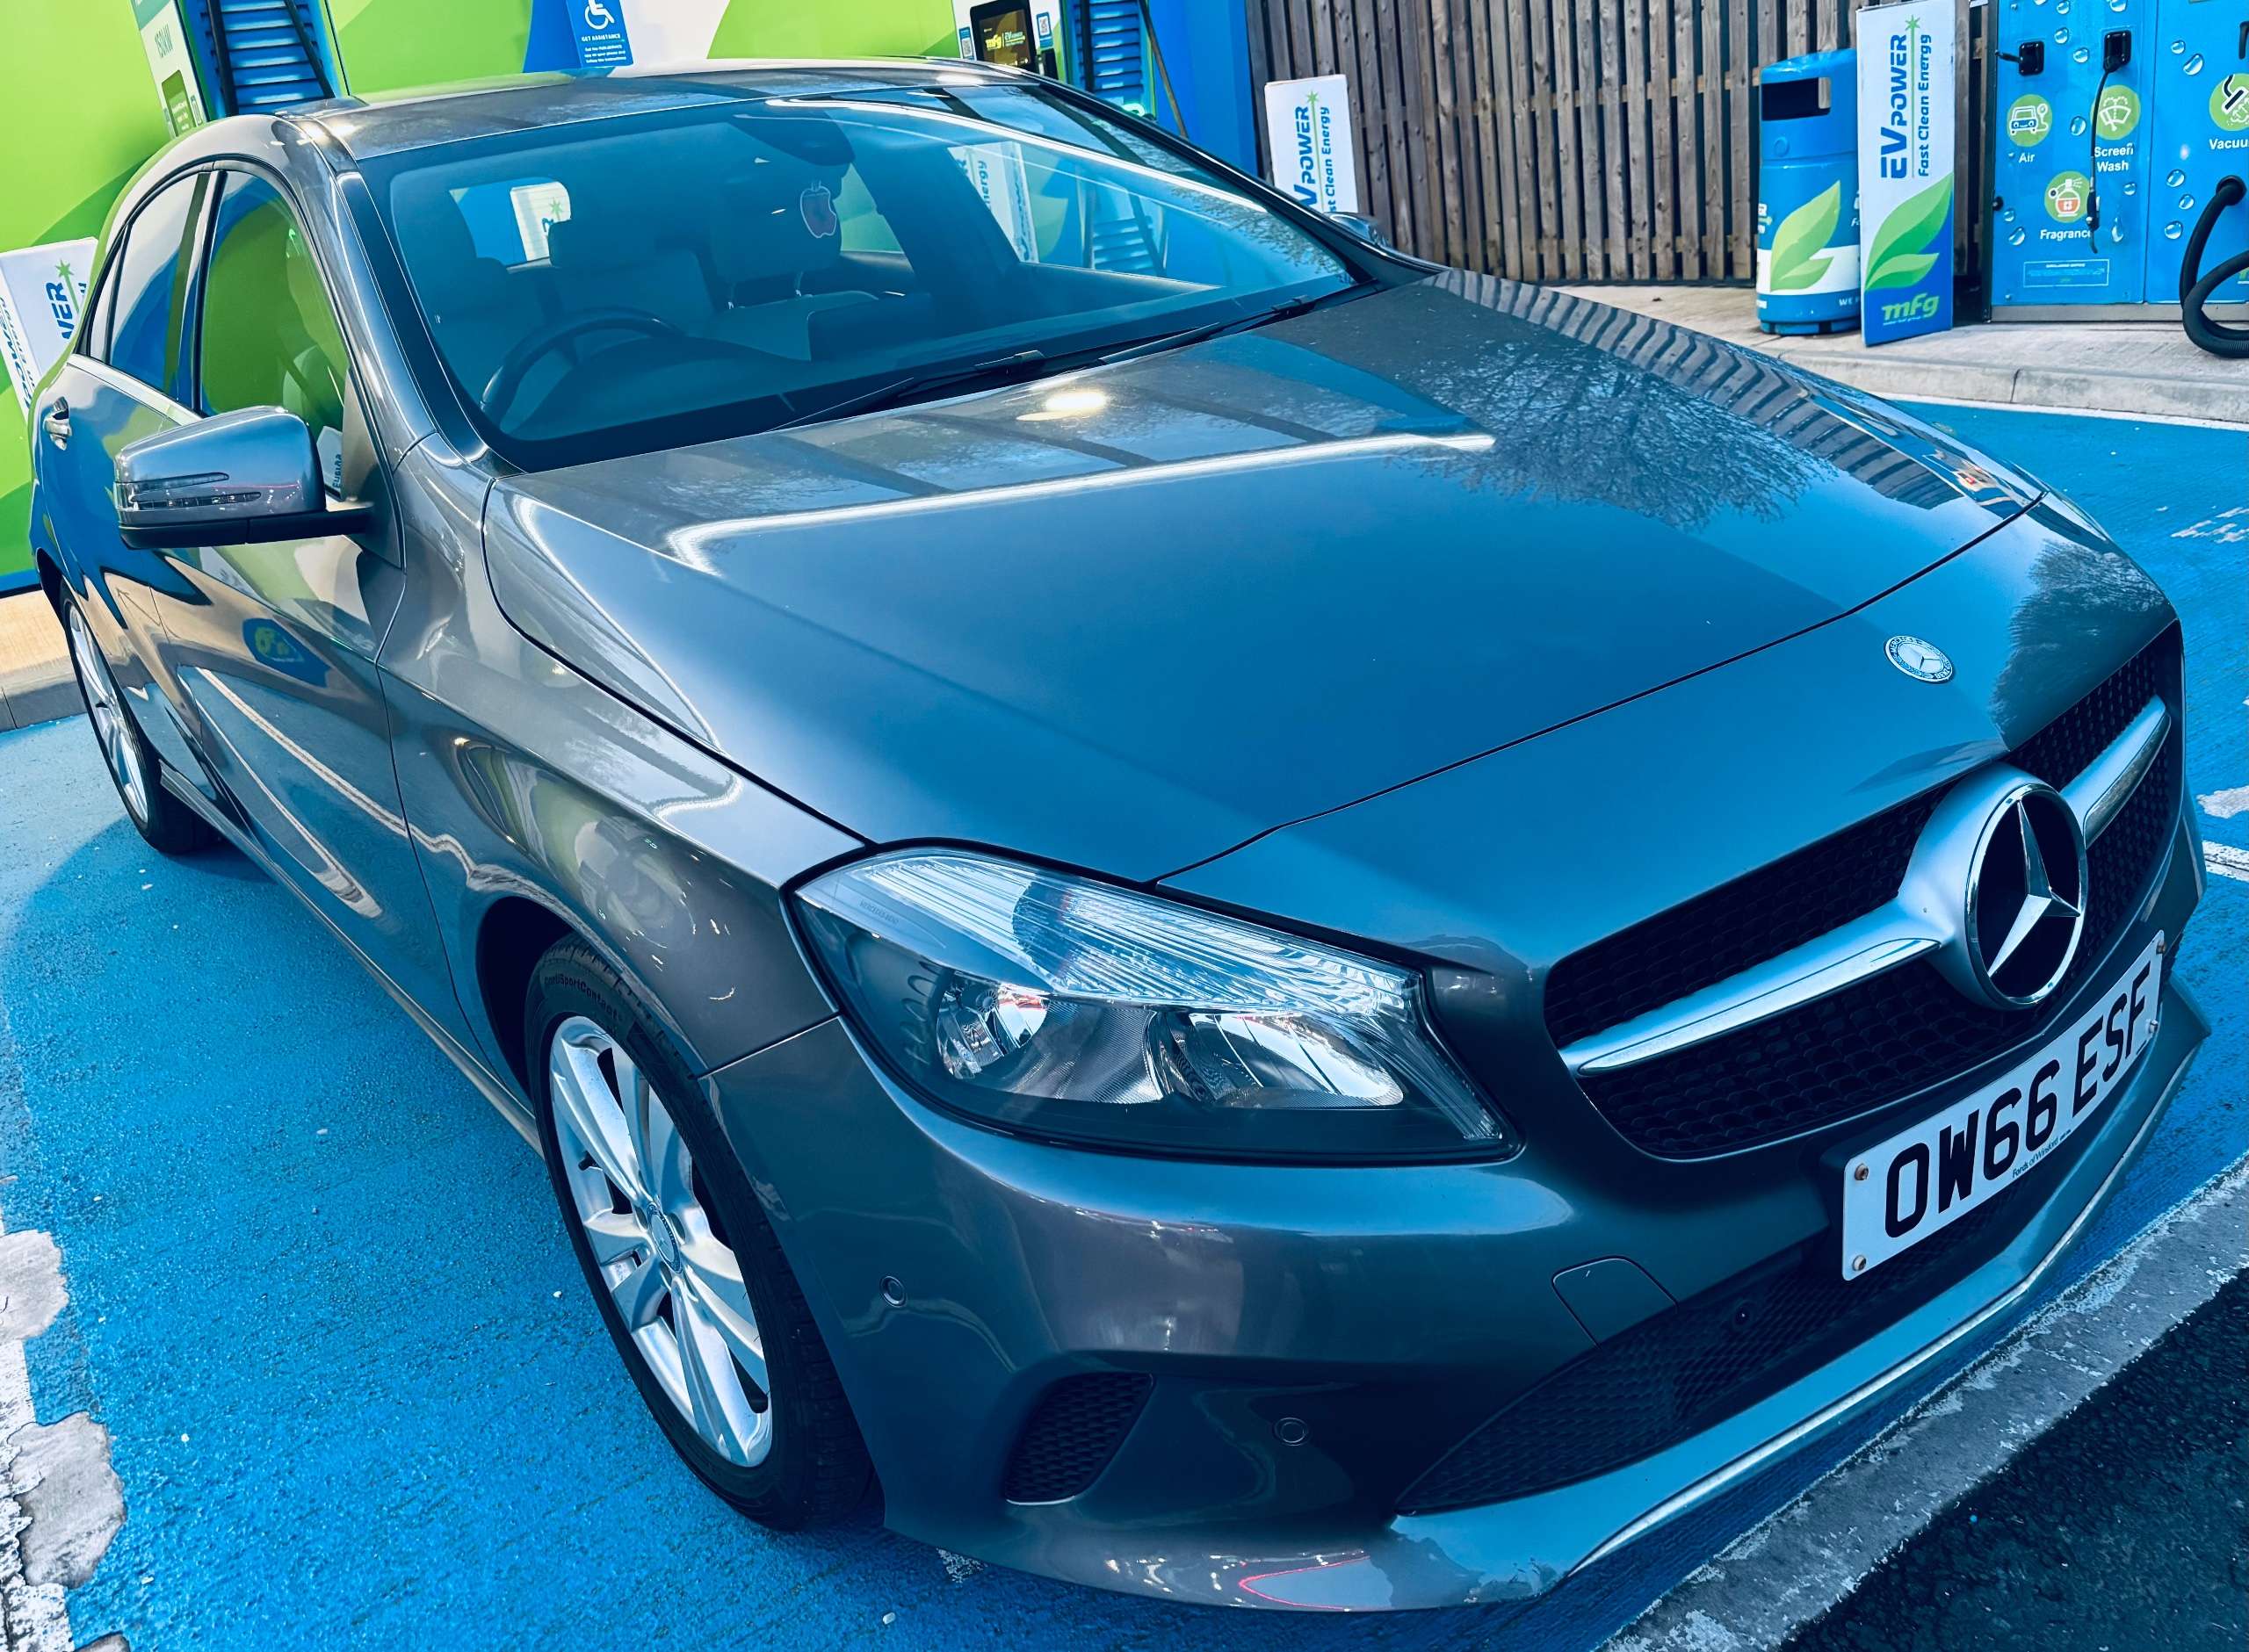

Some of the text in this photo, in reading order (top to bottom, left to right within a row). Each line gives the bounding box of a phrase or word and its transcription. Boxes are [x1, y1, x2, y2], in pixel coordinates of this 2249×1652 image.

[1880, 34, 1907, 179] EV POWER
[1918, 34, 1932, 177] Fast Clean Energy
[1295, 106, 1316, 184] POWER
[1320, 106, 1332, 155] Energy
[2094, 146, 2134, 158] Screen
[2209, 138, 2249, 150] Vacuu
[1322, 159, 1335, 197] Clean
[2018, 152, 2036, 163] Air
[2096, 161, 2130, 173] Wash
[1884, 960, 2151, 1238] OW66 ESF
